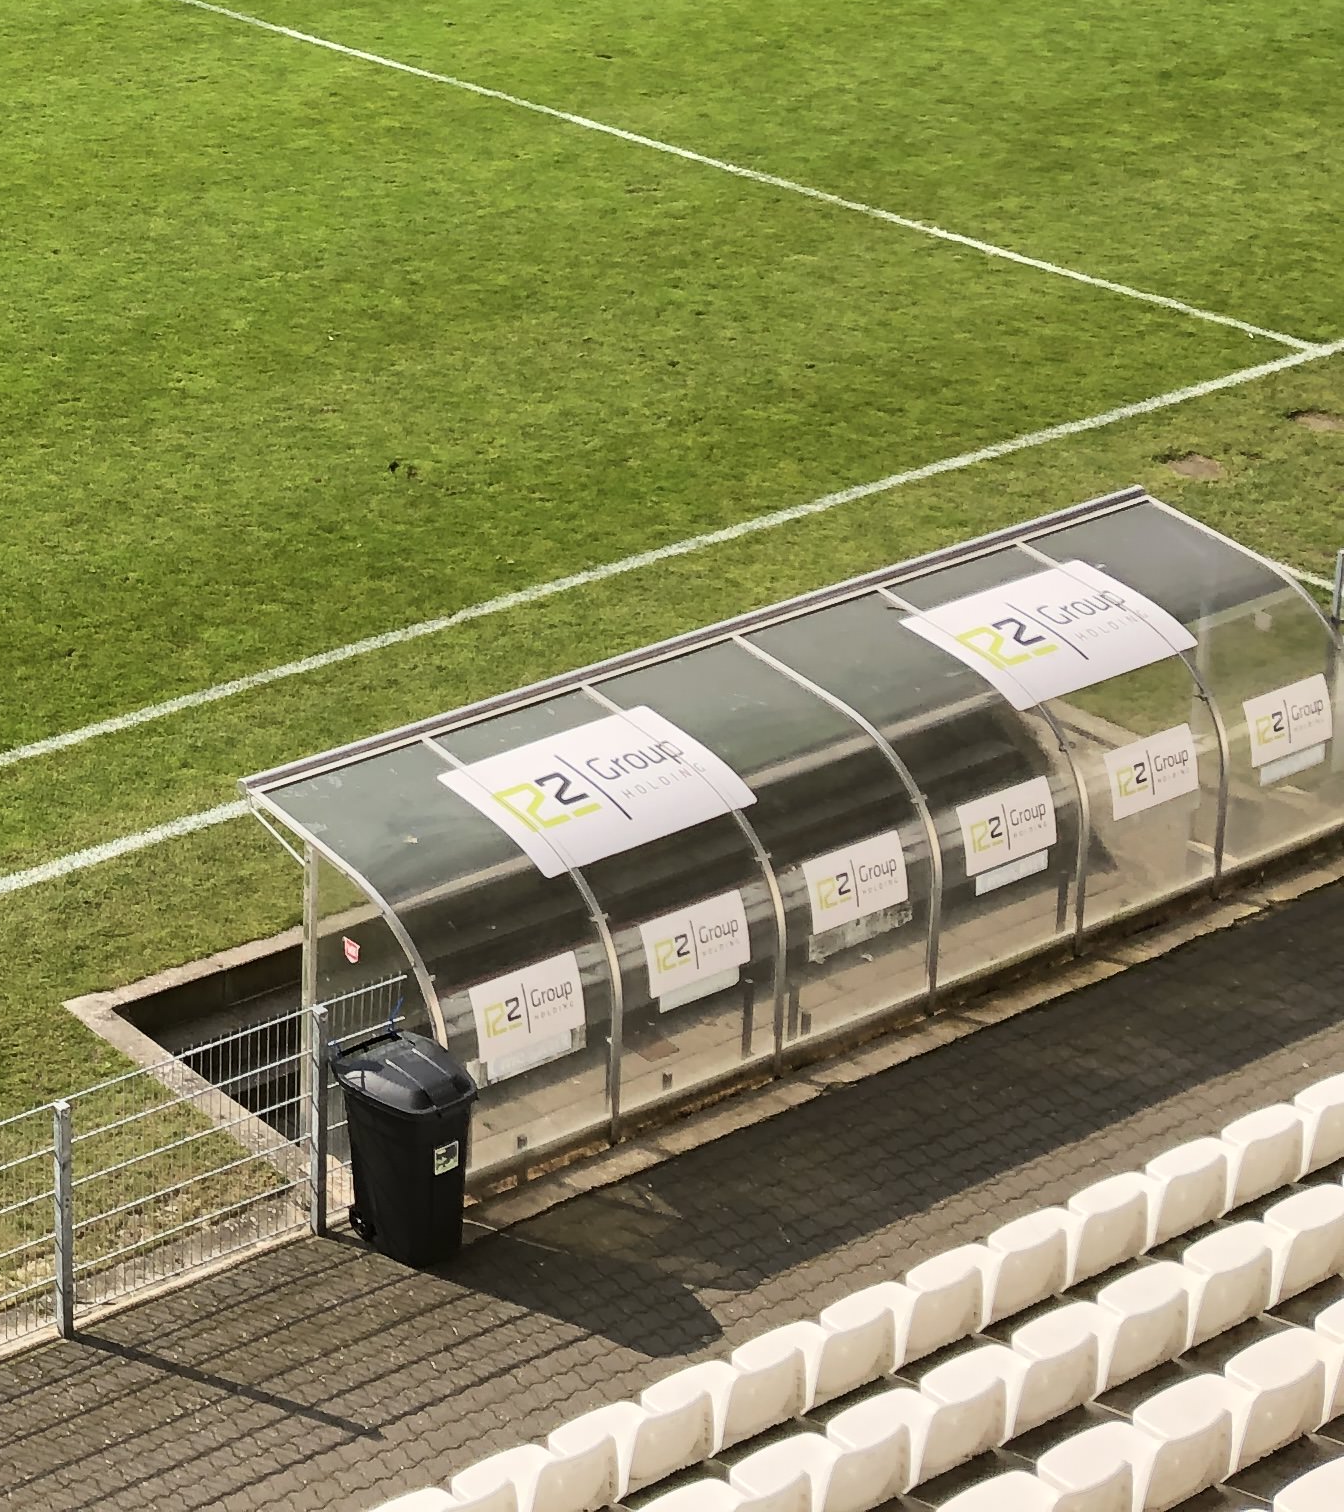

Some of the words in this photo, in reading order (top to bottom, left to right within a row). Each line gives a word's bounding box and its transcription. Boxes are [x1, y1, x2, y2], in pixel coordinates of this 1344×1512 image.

[1044, 588, 1129, 628] Group
[1074, 608, 1149, 643] HOLDING
[1290, 697, 1325, 722] Group
[585, 739, 684, 784] Group
[1154, 747, 1189, 773] Group
[622, 760, 707, 801] HOLDING
[1009, 800, 1047, 827] Group
[858, 856, 898, 884] Group
[697, 917, 739, 944] Group
[530, 980, 573, 1008] Group
